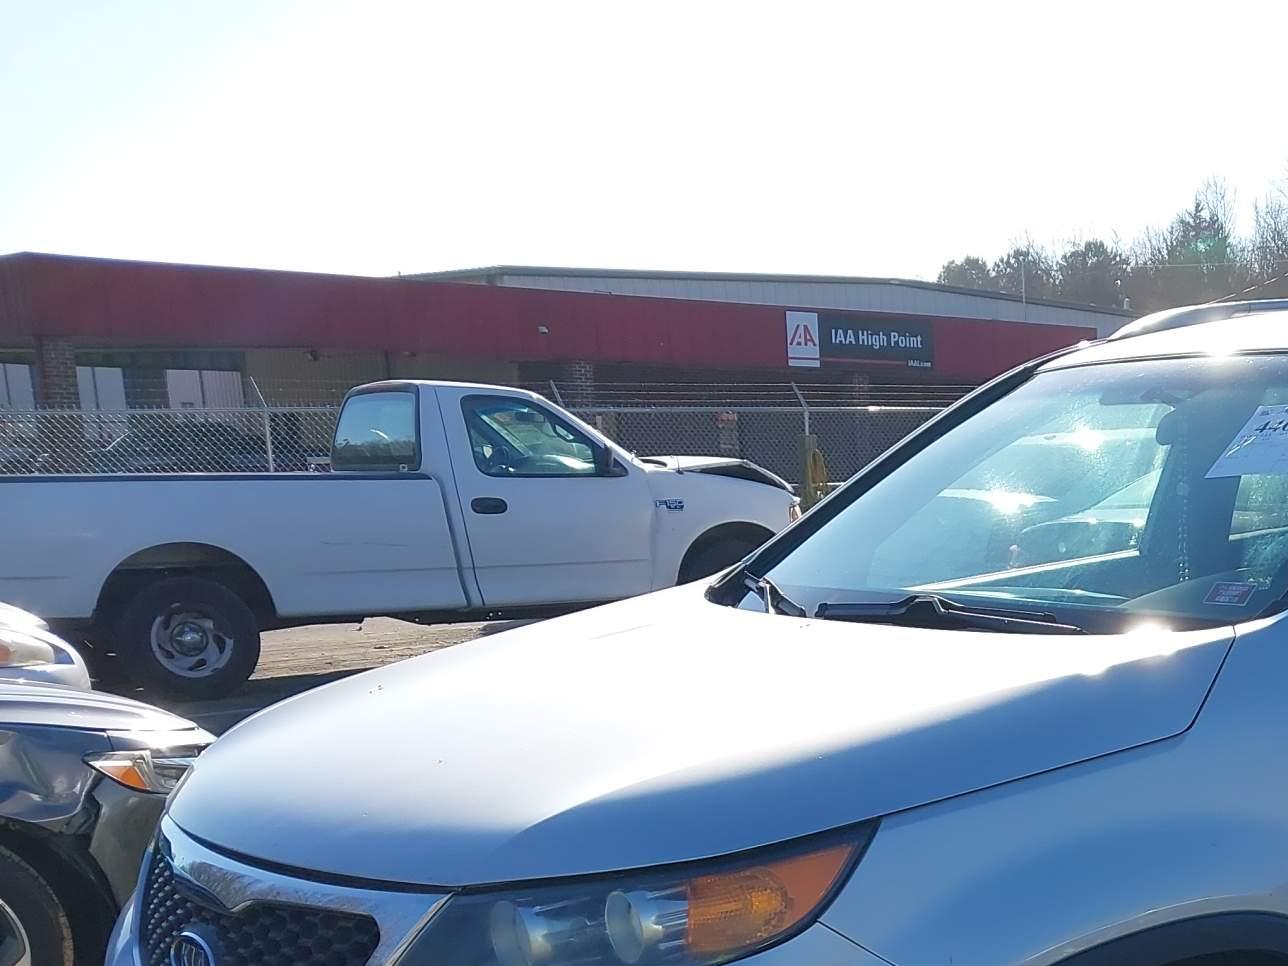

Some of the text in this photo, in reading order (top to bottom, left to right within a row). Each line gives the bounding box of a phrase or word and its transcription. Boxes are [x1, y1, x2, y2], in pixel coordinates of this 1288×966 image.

[831, 328, 923, 350] IAA High Point
